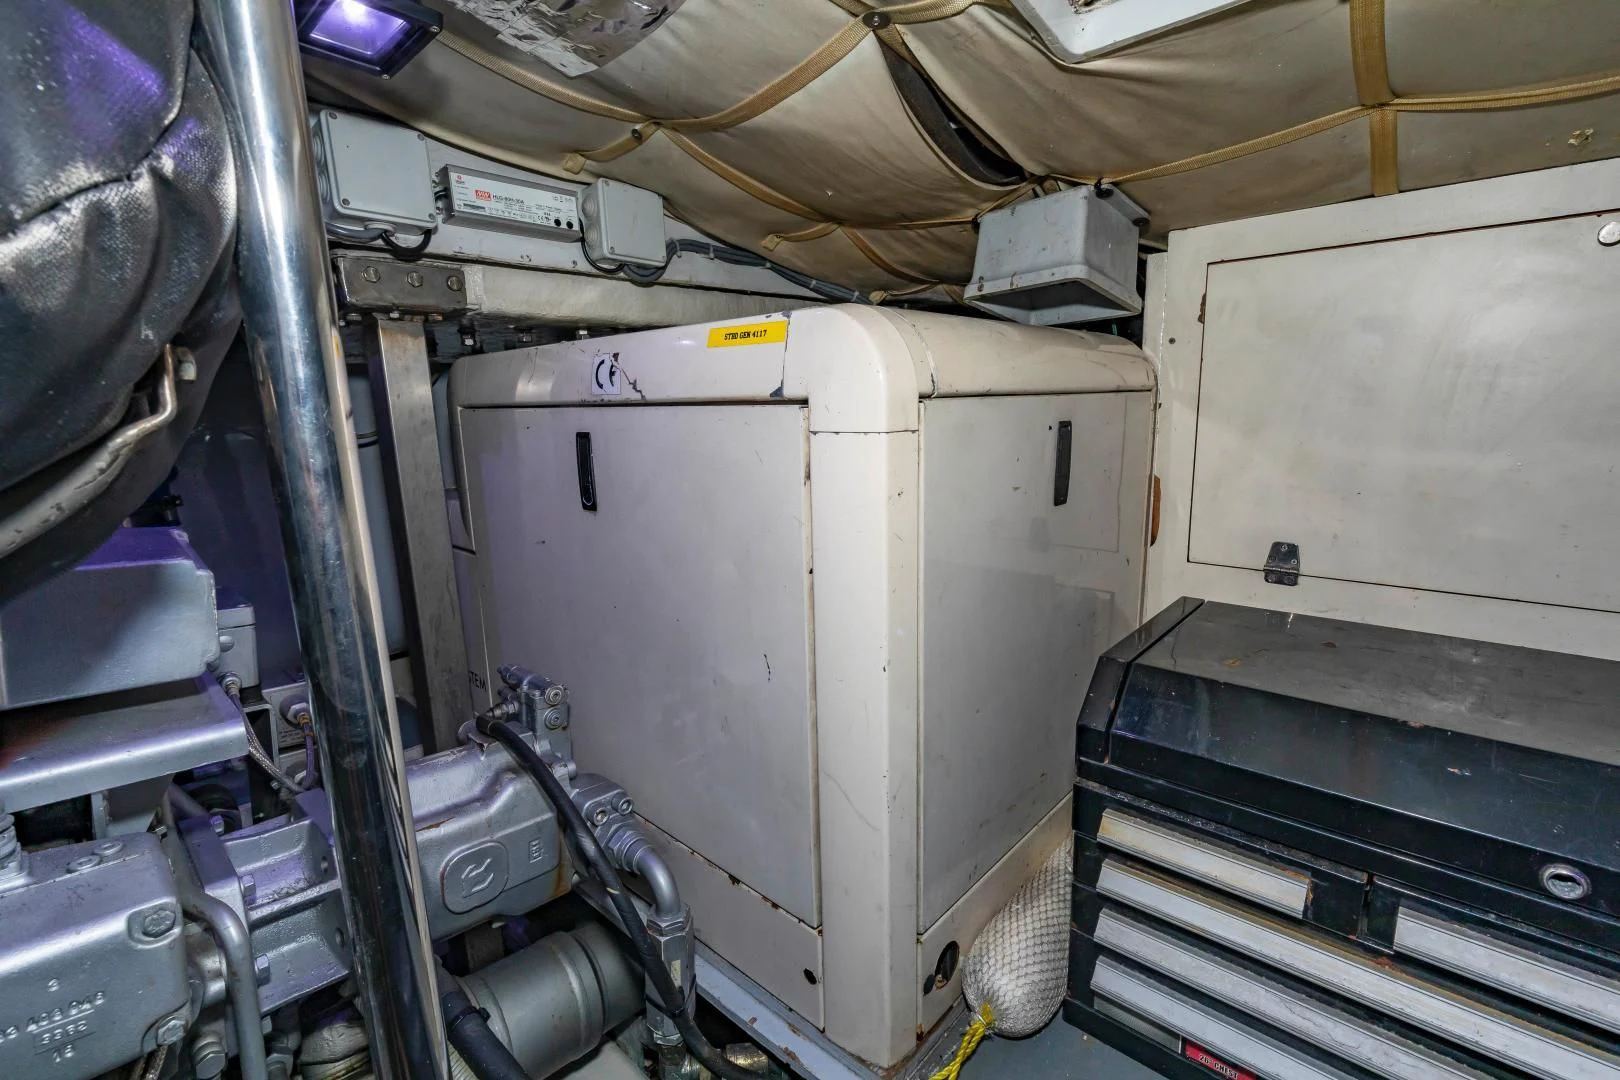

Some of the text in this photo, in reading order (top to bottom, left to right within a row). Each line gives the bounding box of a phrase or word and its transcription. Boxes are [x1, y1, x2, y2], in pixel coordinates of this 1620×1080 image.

[740, 331, 751, 339] GEN
[752, 329, 767, 338] 4117
[1214, 1061, 1239, 1080] CHEST
